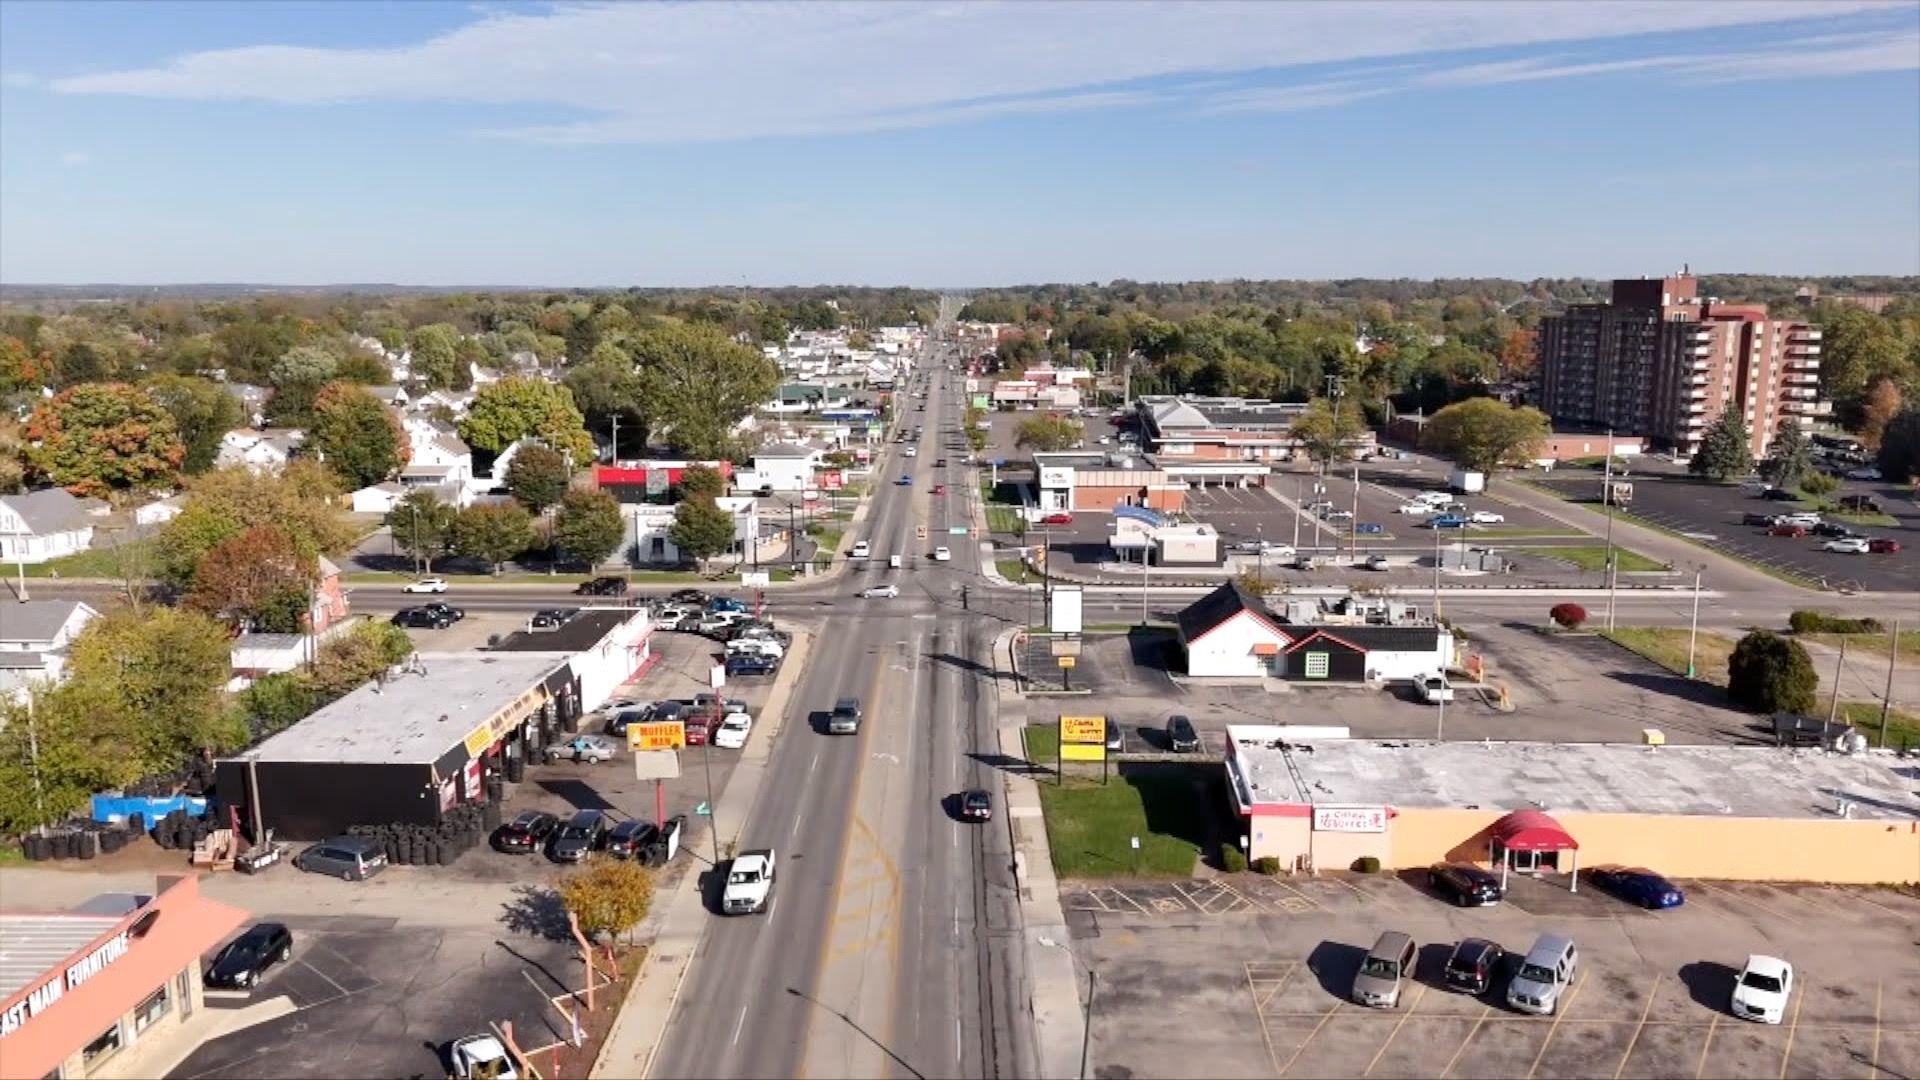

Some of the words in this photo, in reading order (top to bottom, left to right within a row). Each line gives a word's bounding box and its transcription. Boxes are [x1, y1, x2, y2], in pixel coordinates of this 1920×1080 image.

[640, 724, 681, 737] MUFFLER
[650, 737, 671, 746] MAN
[0, 1000, 28, 1037] AST
[28, 975, 63, 1018] MAIN
[66, 930, 129, 990] FURNITURE
